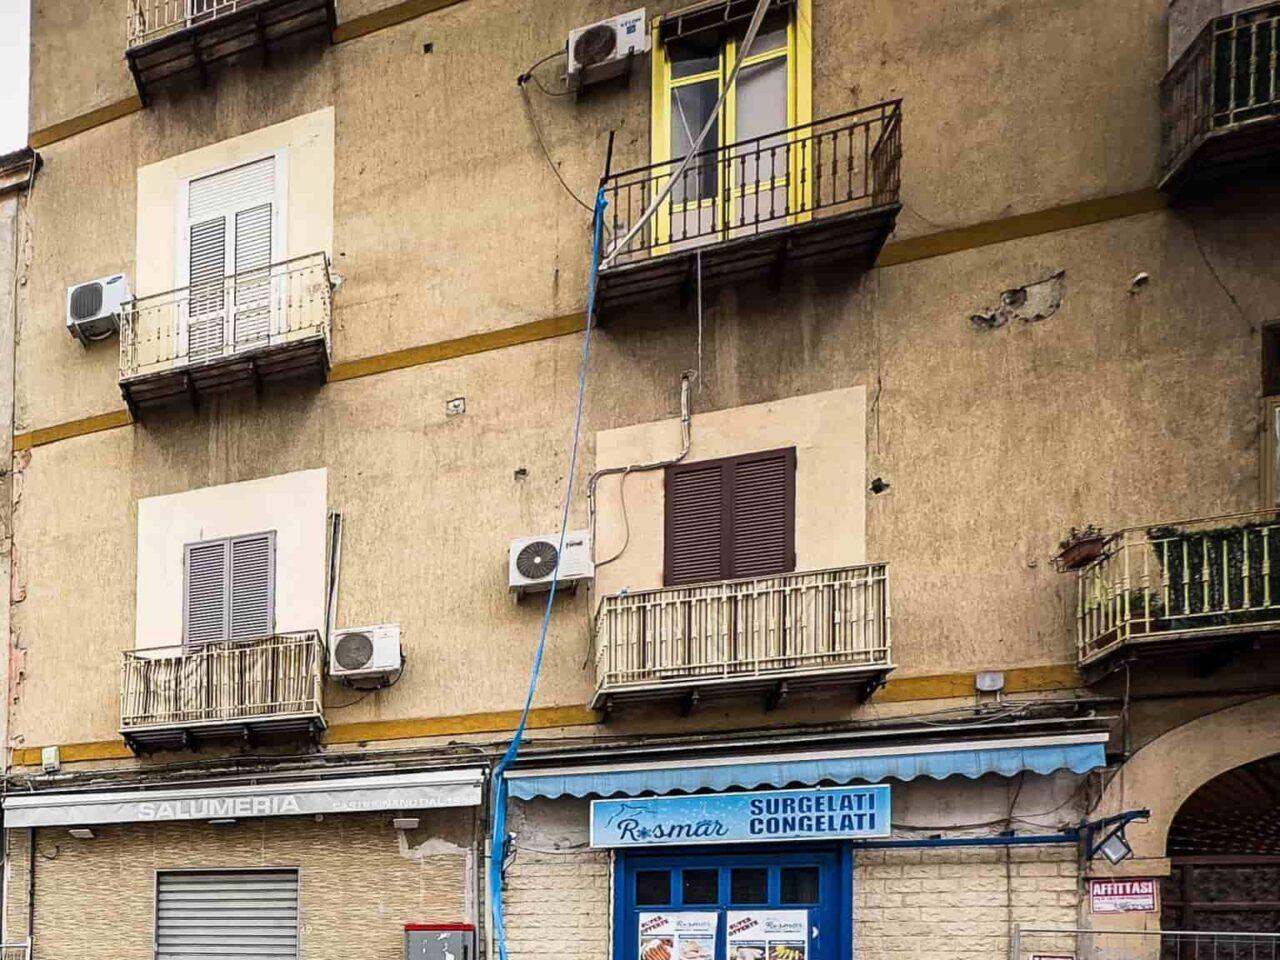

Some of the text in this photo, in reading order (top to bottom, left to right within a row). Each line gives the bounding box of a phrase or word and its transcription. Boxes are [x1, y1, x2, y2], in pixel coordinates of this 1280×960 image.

[138, 795, 301, 819] SALUMERIA
[750, 793, 876, 816] SURGELATI
[750, 813, 876, 835] CONGELATI
[1093, 882, 1153, 895] AFFITTASI
